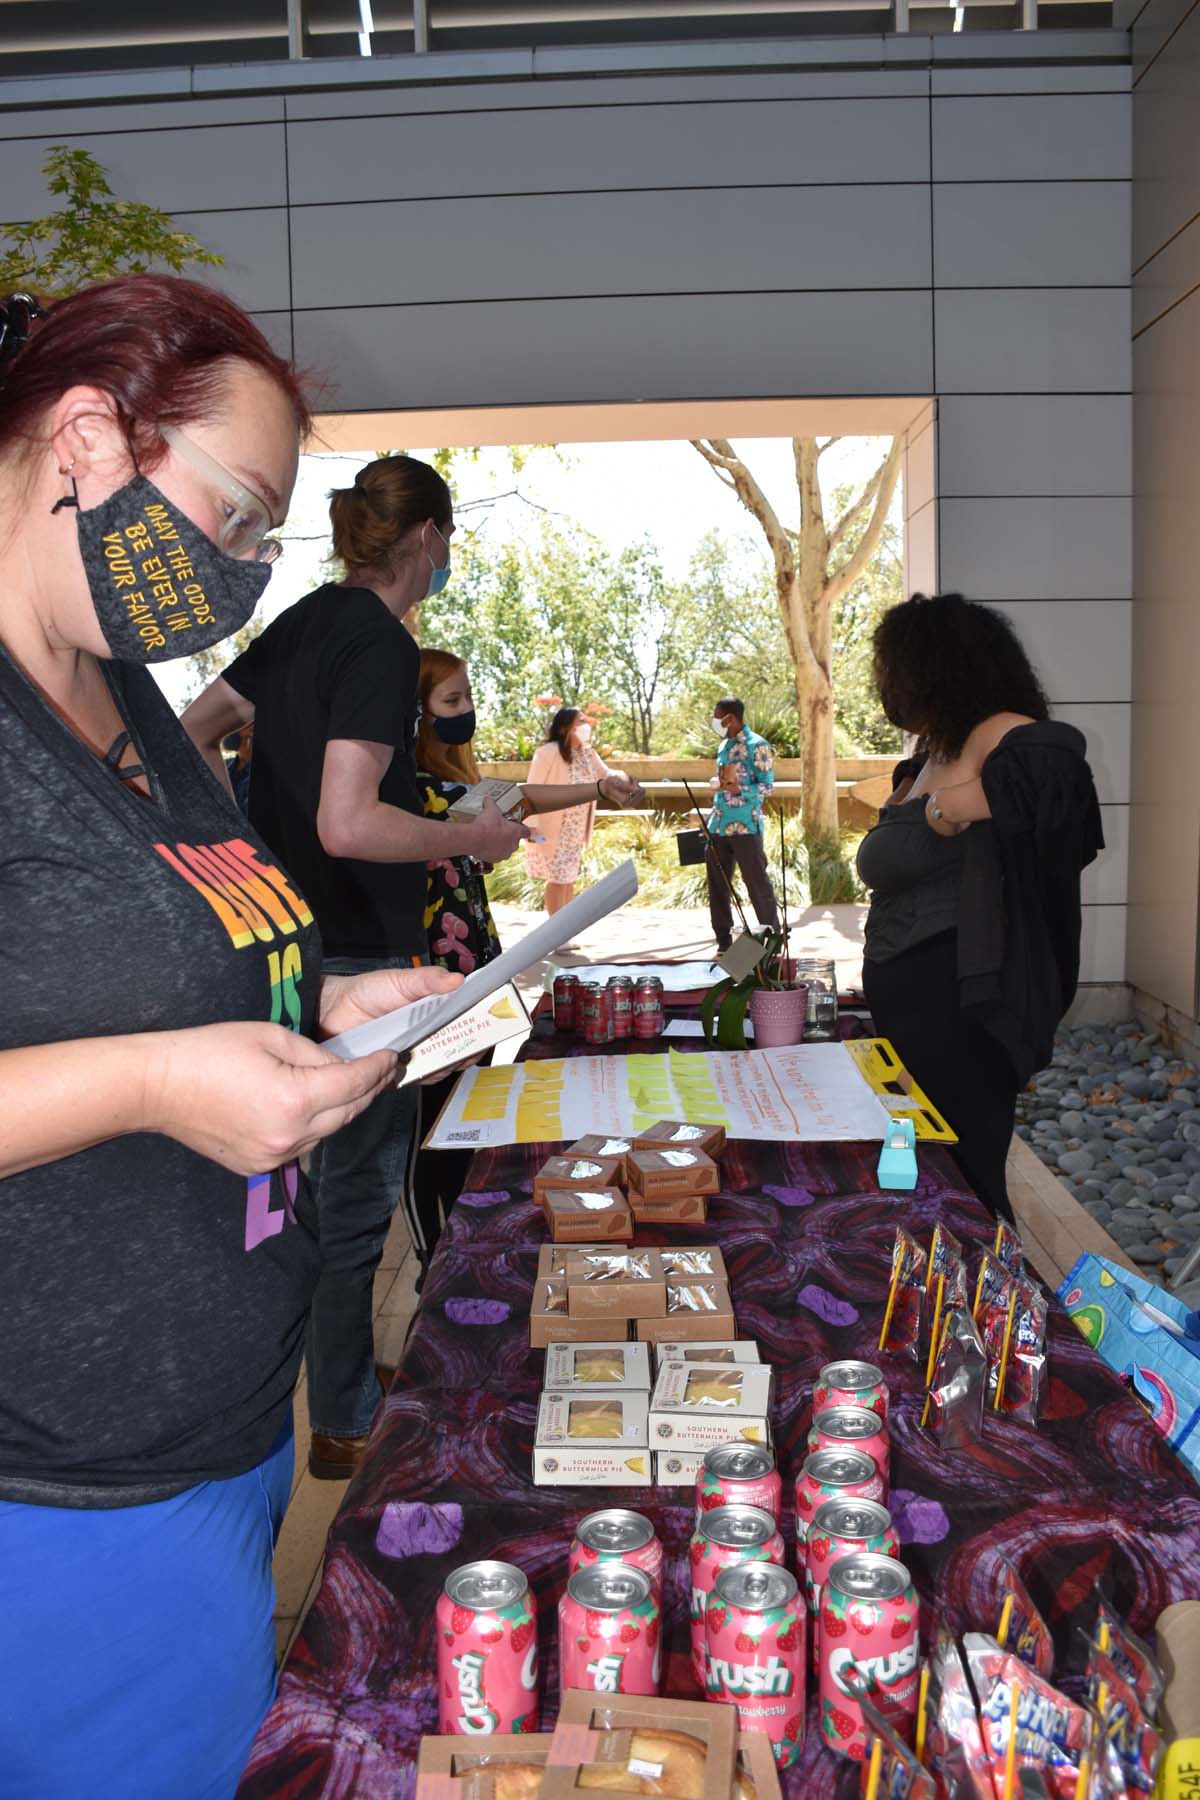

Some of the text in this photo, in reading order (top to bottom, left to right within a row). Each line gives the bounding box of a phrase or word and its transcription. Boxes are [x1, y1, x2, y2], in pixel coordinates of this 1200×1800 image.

[125, 521, 192, 632] BE EVER IN
[144, 503, 216, 626] MAY THE ODDS
[102, 531, 167, 651] YOUR FAVOR
[419, 1029, 475, 1056] BUTTERMILK
[475, 1020, 493, 1032] PIE
[429, 1015, 477, 1042] SOUTHERN
[677, 1432, 723, 1440] BUTTERMILK
[687, 1425, 728, 1434] SOUTHERN
[562, 1465, 609, 1473] BUTTERMILK
[706, 1655, 791, 1694] rush
[452, 1653, 497, 1735] Crush
[738, 1703, 787, 1717] rawberry
